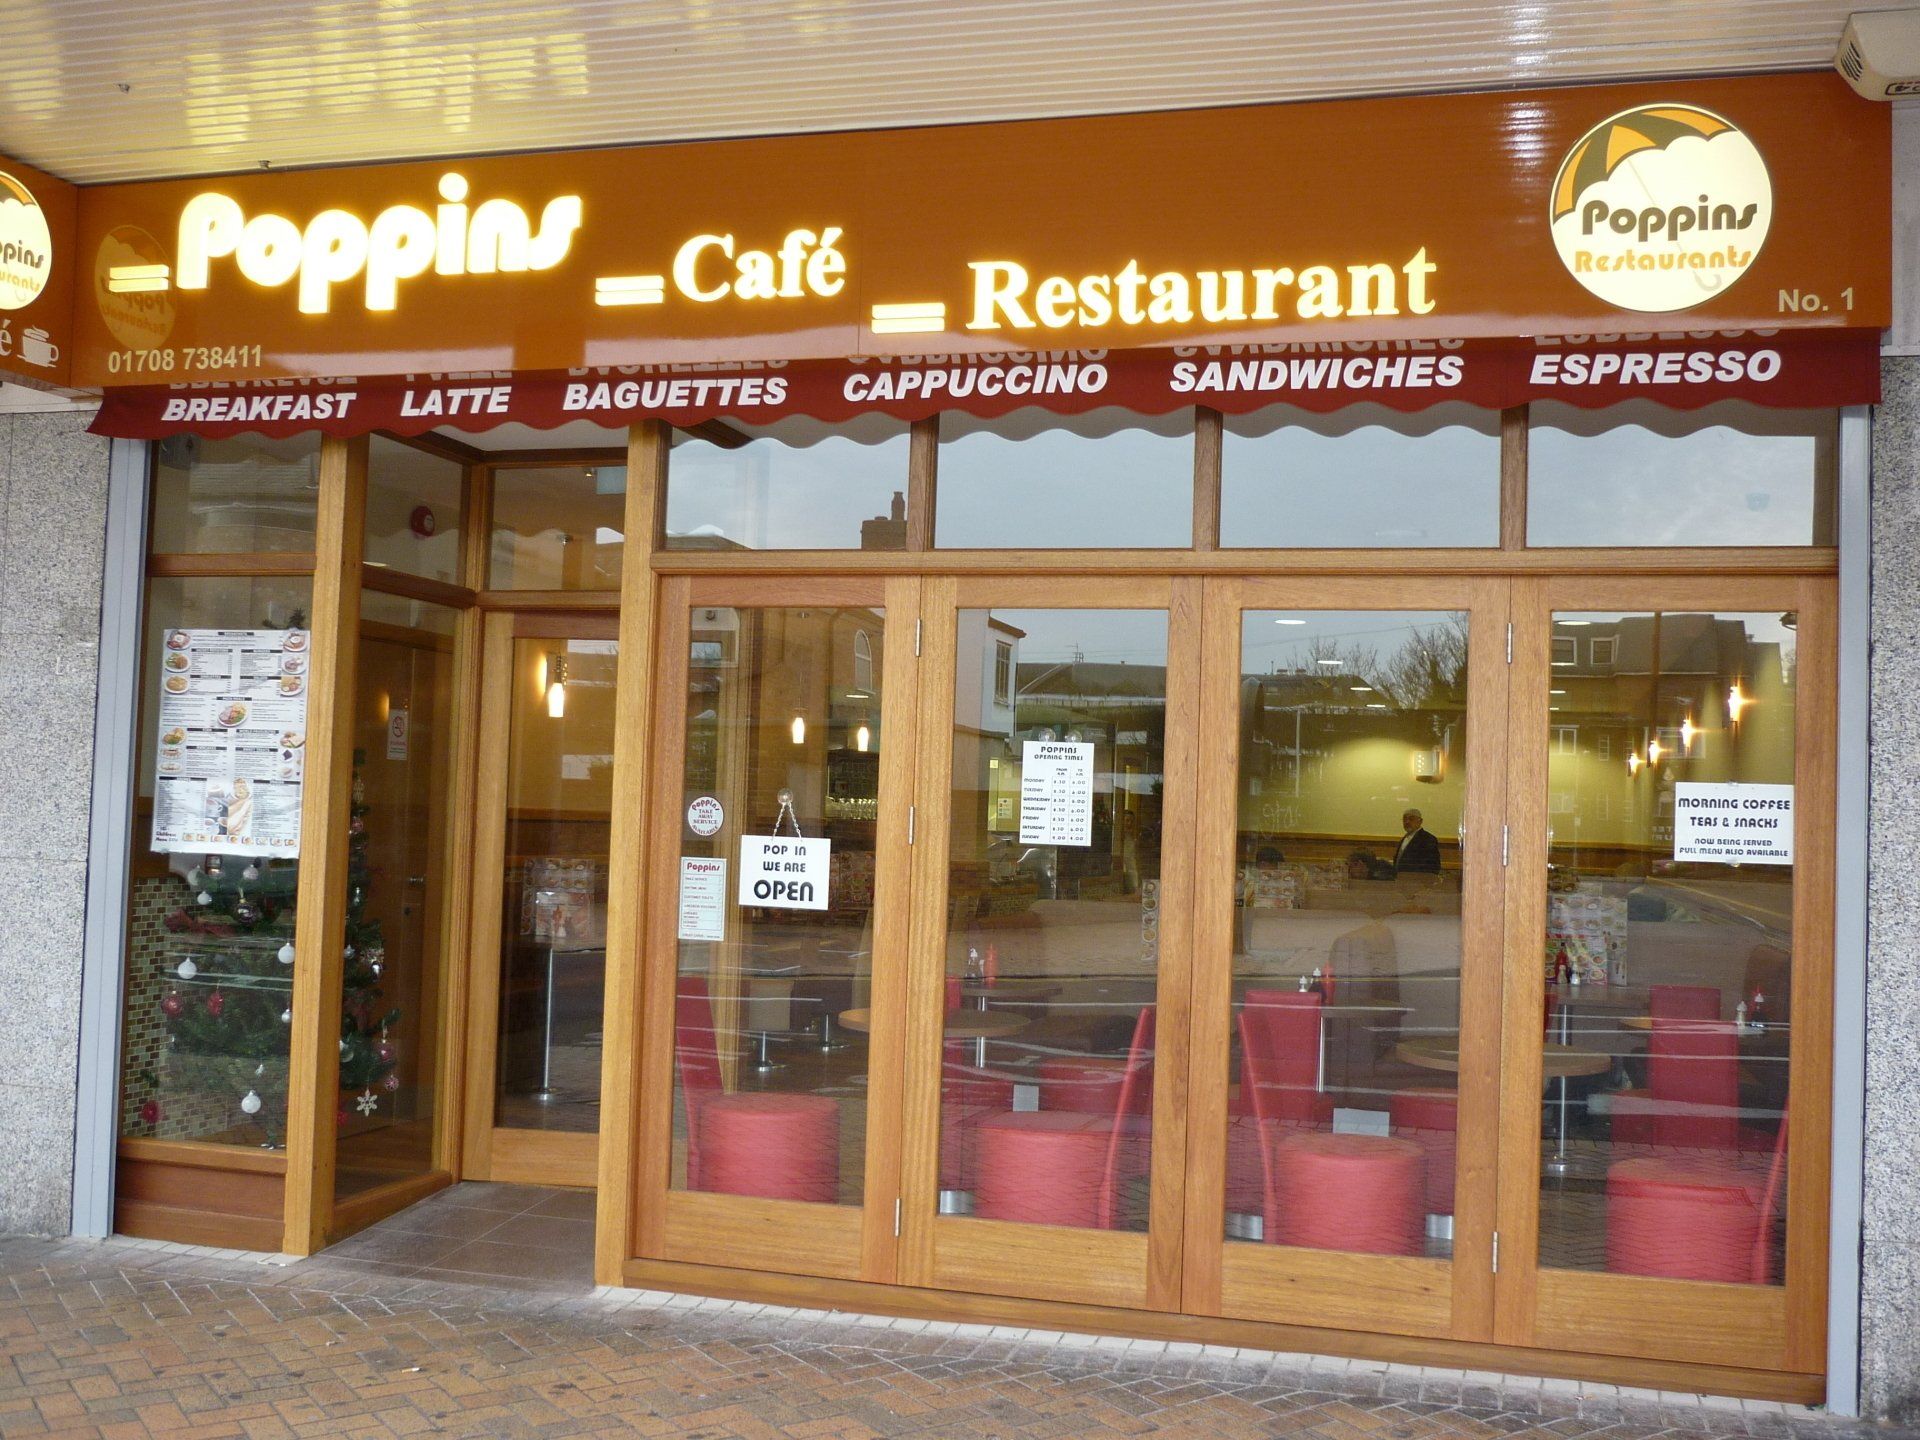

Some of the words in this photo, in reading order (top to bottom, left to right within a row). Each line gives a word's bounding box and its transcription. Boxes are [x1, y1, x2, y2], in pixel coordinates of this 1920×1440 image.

[1582, 194, 1758, 242] Poppins
[0, 239, 44, 270] pins
[176, 172, 582, 314] Poppins
[672, 226, 847, 303] Café
[965, 245, 1438, 331] Restaurant
[1574, 245, 1752, 273] Restaurants
[1778, 288, 1829, 313] No.
[1840, 286, 1855, 312] 1
[108, 348, 175, 374] 01708
[183, 344, 262, 370] 738411
[160, 391, 358, 422] BREAKFAST
[400, 386, 512, 418] LATTE
[560, 376, 789, 411] BAGUETTES
[841, 362, 1110, 402] CAPPUCCINO
[1168, 353, 1466, 393] SANDWICHES
[1527, 348, 1784, 387] ESPRESSO
[1040, 746, 1077, 754] POPPINS
[1678, 798, 1738, 809] MORNING
[1742, 799, 1791, 810] COFFEE
[1690, 816, 1718, 827] TEAS
[1722, 817, 1730, 827] &
[1734, 817, 1778, 829] SNACKS
[763, 844, 788, 855] POP
[794, 845, 806, 856] IN
[1725, 848, 1744, 856] ALSO
[1746, 848, 1788, 857] AVAILABLE
[686, 862, 720, 873] Poppins
[762, 861, 781, 872] WE
[784, 862, 806, 873] ARE
[753, 879, 814, 902] OPEN
